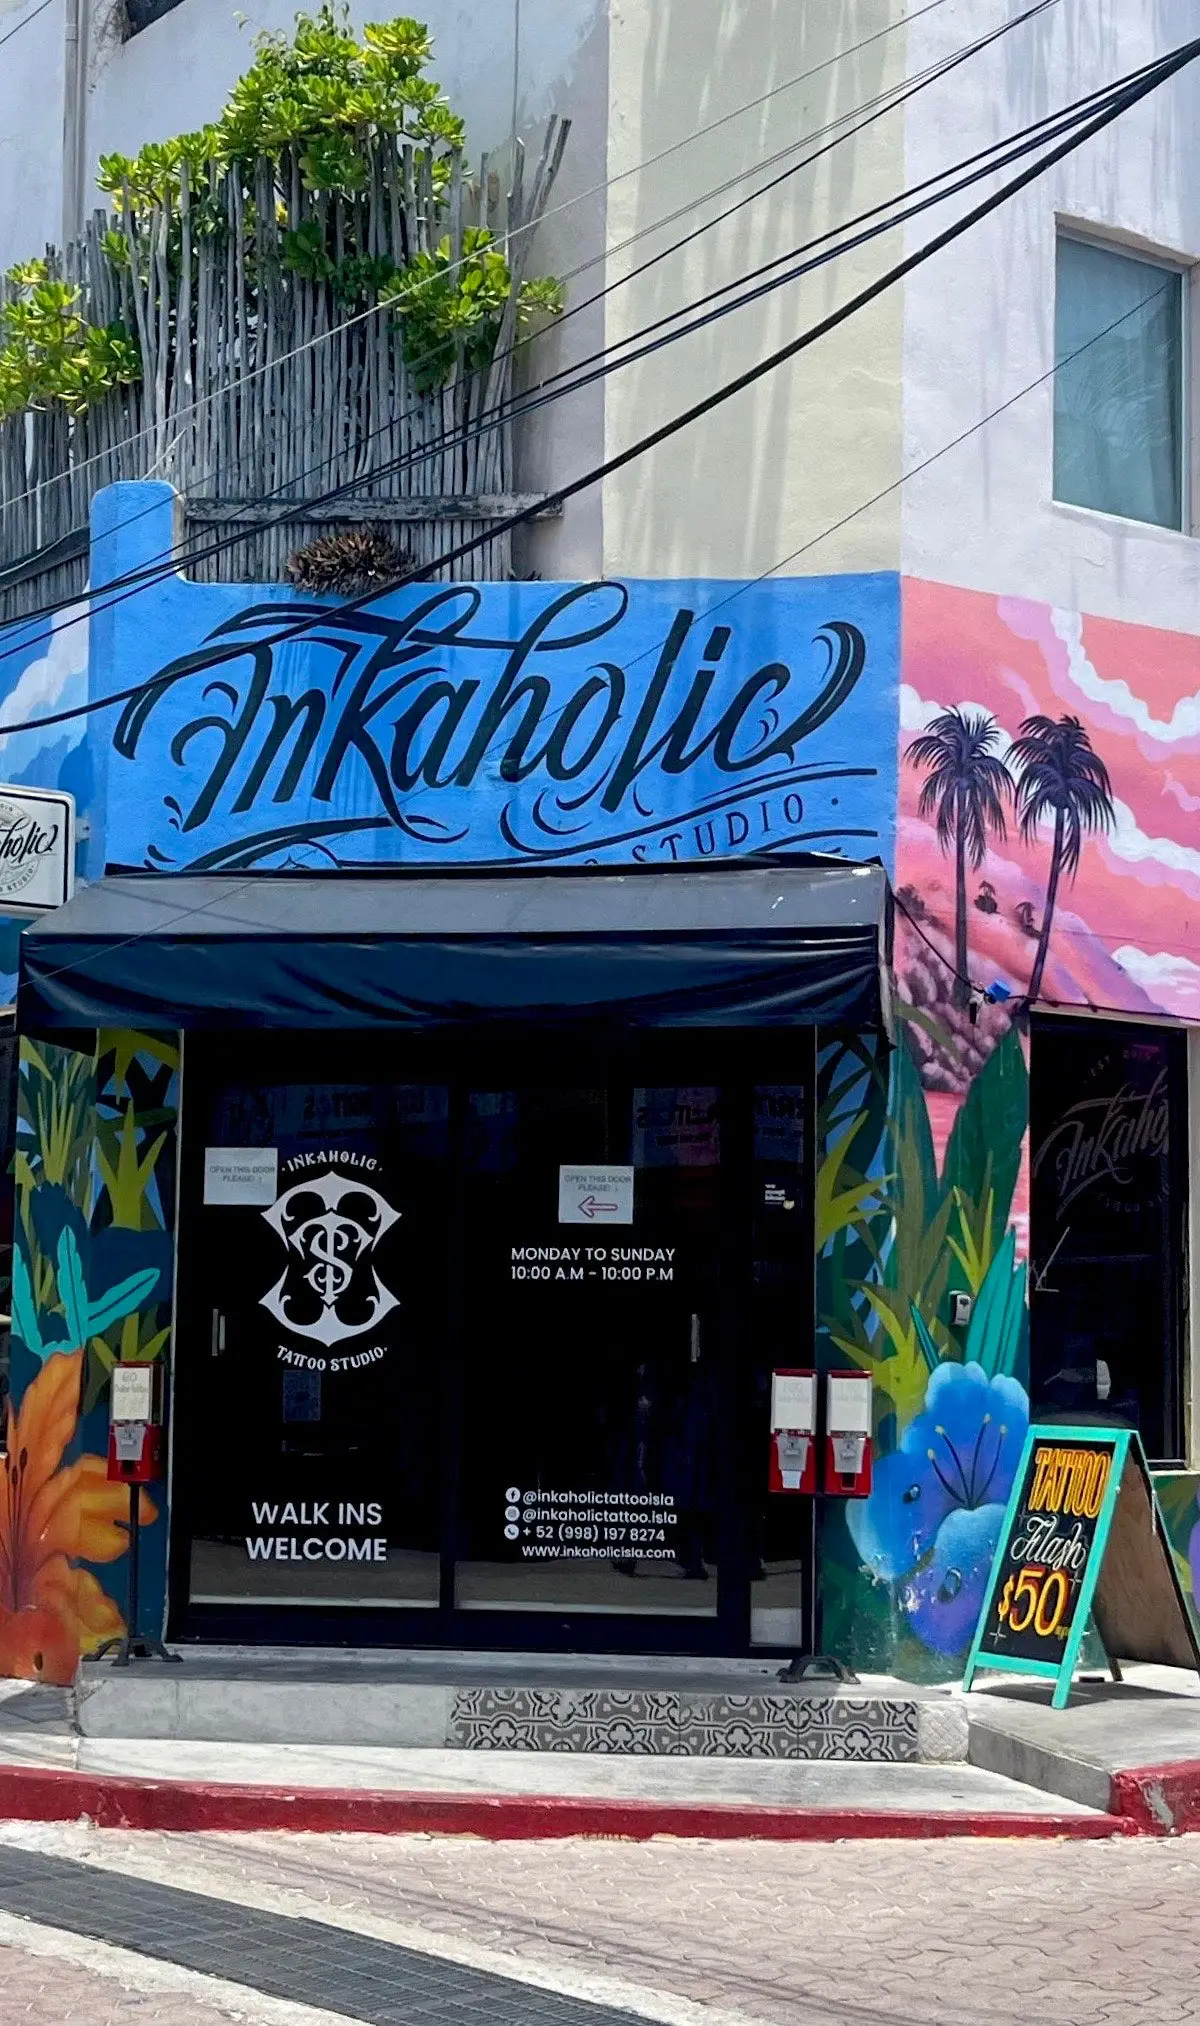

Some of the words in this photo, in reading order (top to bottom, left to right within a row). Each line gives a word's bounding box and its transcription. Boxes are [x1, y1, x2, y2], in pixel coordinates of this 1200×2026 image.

[114, 582, 865, 842] Inkaholic
[0, 816, 58, 863] holic
[209, 1165, 232, 1173] OPEN
[233, 1165, 251, 1173] THIS
[252, 1165, 275, 1173] DOOR
[287, 1150, 378, 1172] INKAHOLIC
[588, 1175, 606, 1183] THIS
[608, 1175, 631, 1183] DOOR
[511, 1247, 581, 1261] MONDAY
[585, 1248, 607, 1261] TO
[611, 1248, 675, 1261] SUNDAY
[511, 1266, 551, 1280] 10:00
[555, 1267, 584, 1280] A.M
[602, 1266, 642, 1280] 10:00
[646, 1267, 674, 1281] P.M
[277, 1345, 326, 1371] TATTOO
[330, 1346, 384, 1371] STUDIO
[1027, 1447, 1111, 1519] TATTOO
[522, 1490, 674, 1506] @inkaholictattooisla
[251, 1502, 330, 1525] WALK
[338, 1502, 383, 1526] INS
[522, 1507, 678, 1524] @inkaholictattoo.isla
[536, 1526, 554, 1539] 52
[558, 1524, 599, 1542] (998)
[603, 1527, 626, 1541] 197
[629, 1528, 665, 1542] 8274
[1010, 1516, 1087, 1571] Flash
[245, 1537, 388, 1561] WELCOME
[998, 1567, 1071, 1637] $50
